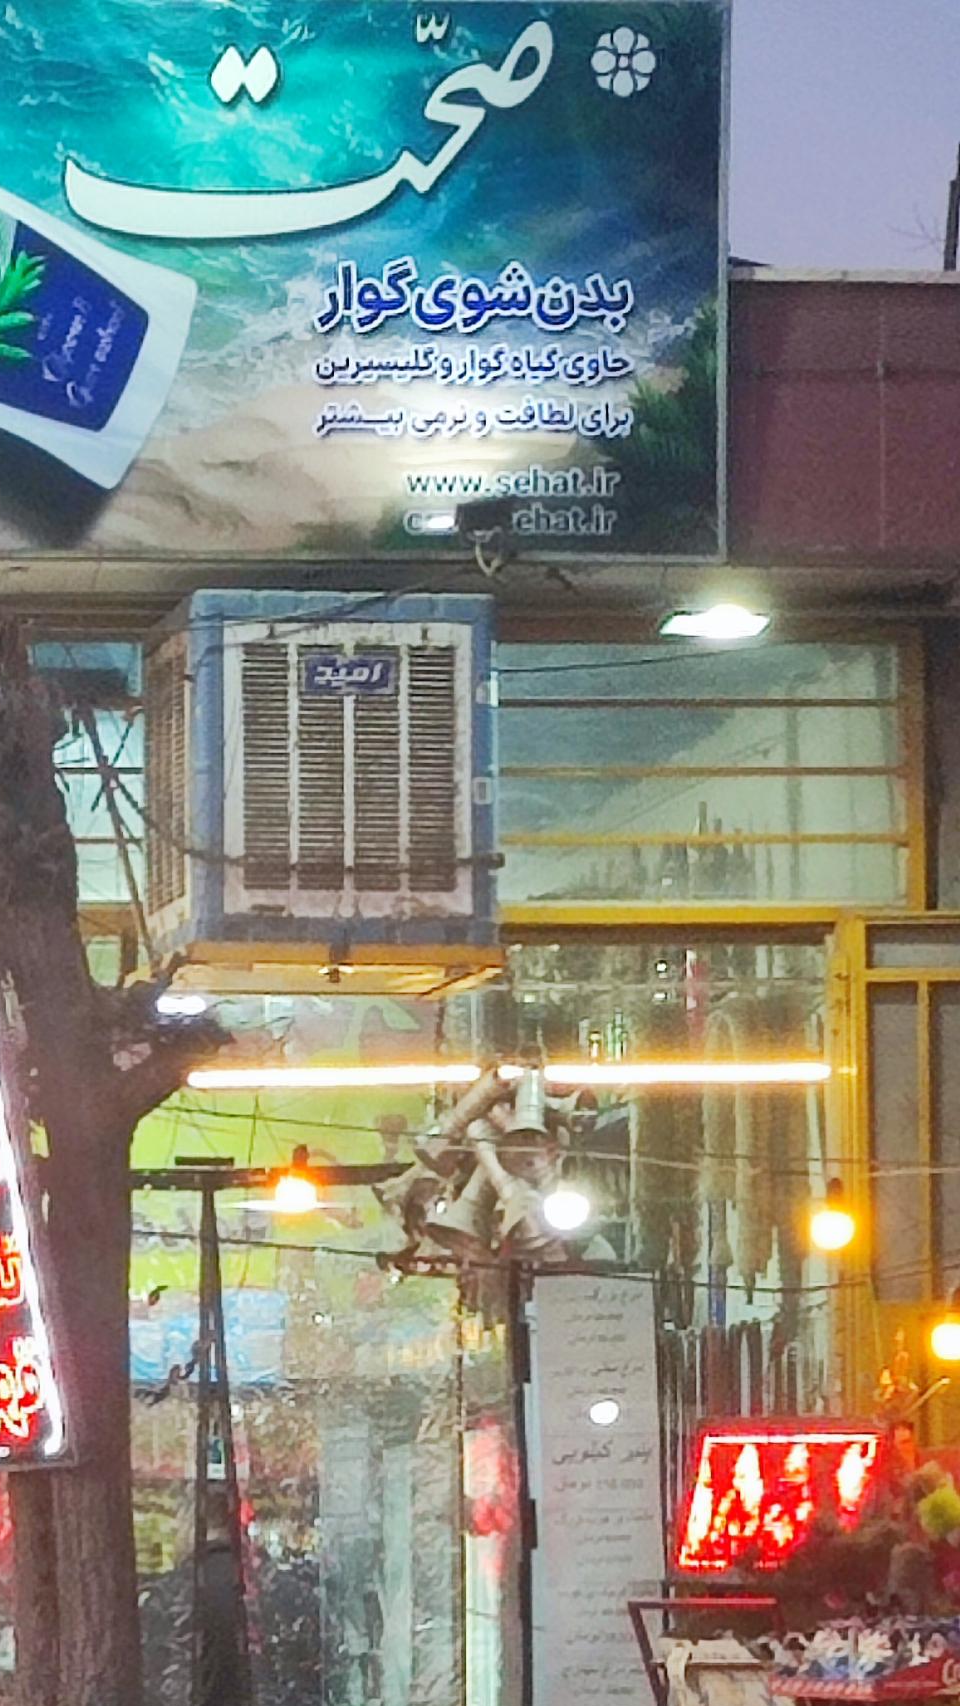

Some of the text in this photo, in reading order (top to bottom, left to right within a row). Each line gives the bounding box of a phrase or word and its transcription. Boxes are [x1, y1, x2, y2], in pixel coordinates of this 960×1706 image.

[316, 256, 632, 332] بدن شوی گوار
[315, 346, 632, 383] حاوی گیاه گوار و گلیسیرین
[411, 403, 467, 434] نرمی
[471, 407, 487, 434] و
[495, 396, 574, 429] لطافت
[581, 403, 633, 436] برای
[405, 464, 621, 497] www.sehat.ir
